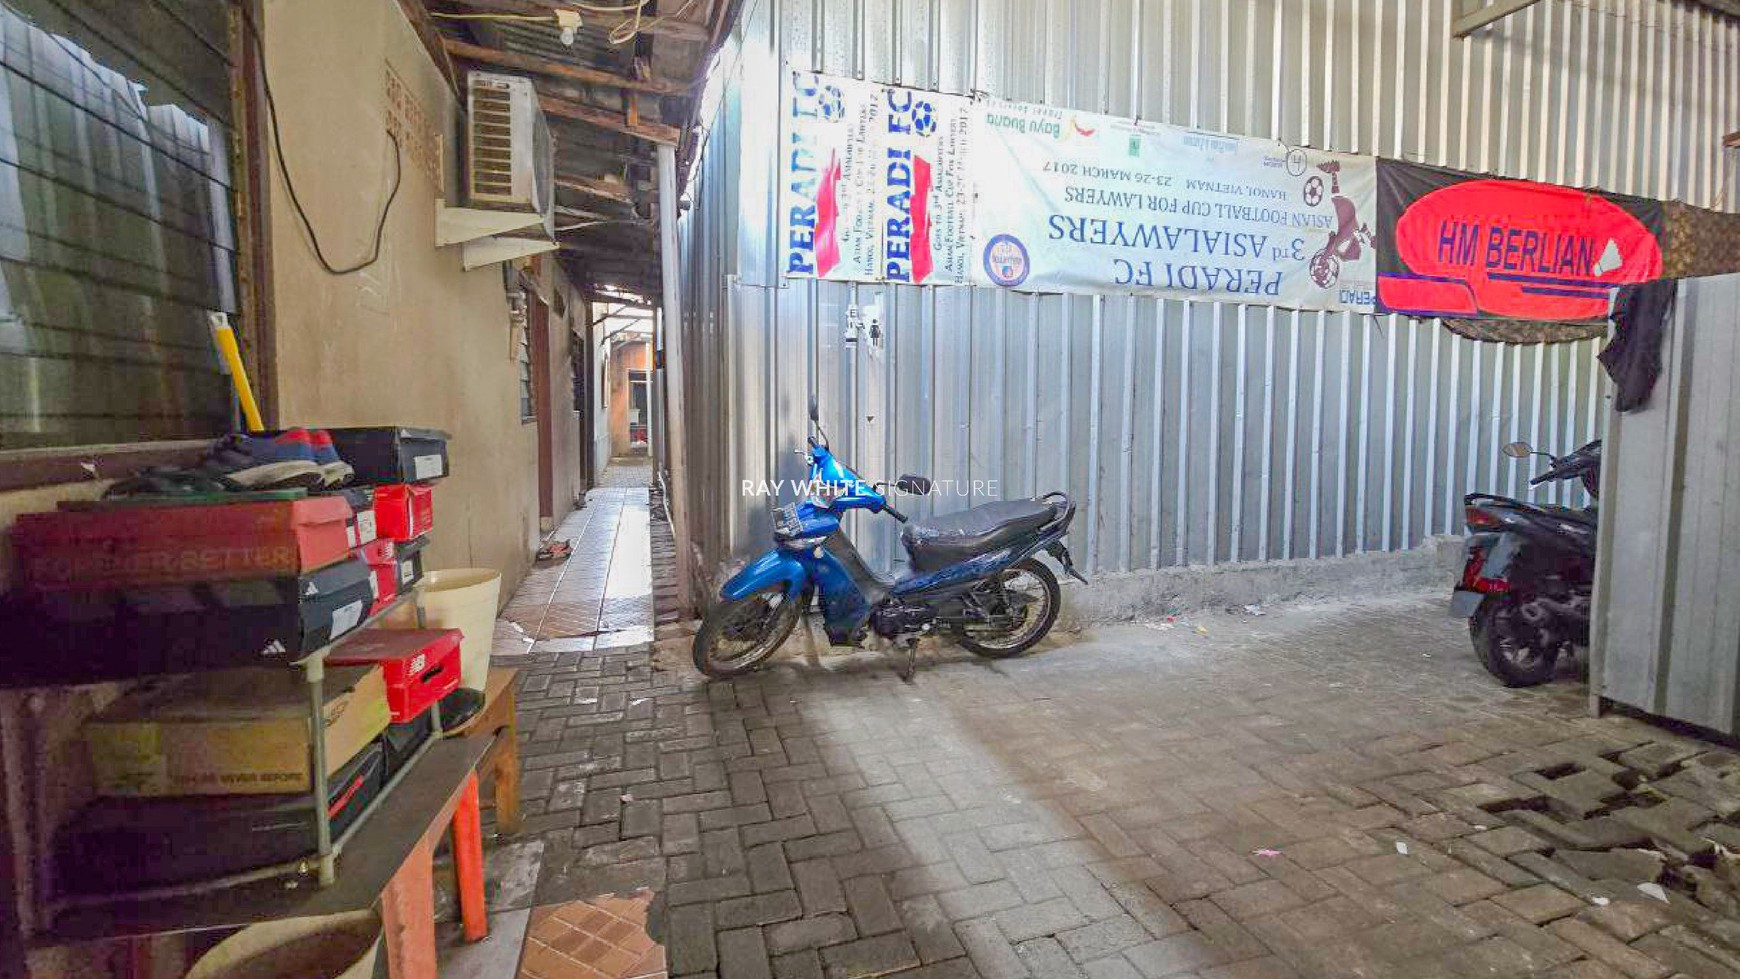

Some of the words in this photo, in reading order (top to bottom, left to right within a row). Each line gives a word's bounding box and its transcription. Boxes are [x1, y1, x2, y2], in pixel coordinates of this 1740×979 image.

[887, 89, 912, 134] FC
[986, 114, 1026, 134] Buana
[1029, 118, 1060, 139] Bayu
[1043, 161, 1078, 176] 2017
[1083, 166, 1132, 181] MARCH
[1135, 173, 1172, 187] 23-26
[1186, 180, 1243, 196] VIETNAM
[1064, 186, 1142, 210] LAWYERS
[1147, 194, 1177, 213] FOR
[1182, 200, 1211, 217] CUP
[886, 146, 911, 283] PERADI
[1214, 204, 1287, 226] FOOTBALL
[1291, 213, 1333, 229] ASIAN
[1049, 215, 1268, 259] ASIALAWYERS
[1272, 238, 1305, 261] 3rd
[1438, 221, 1479, 265] HM
[1485, 228, 1593, 276] BERLIAN
[1114, 258, 1154, 287] FC
[1165, 263, 1284, 296] PERADI
